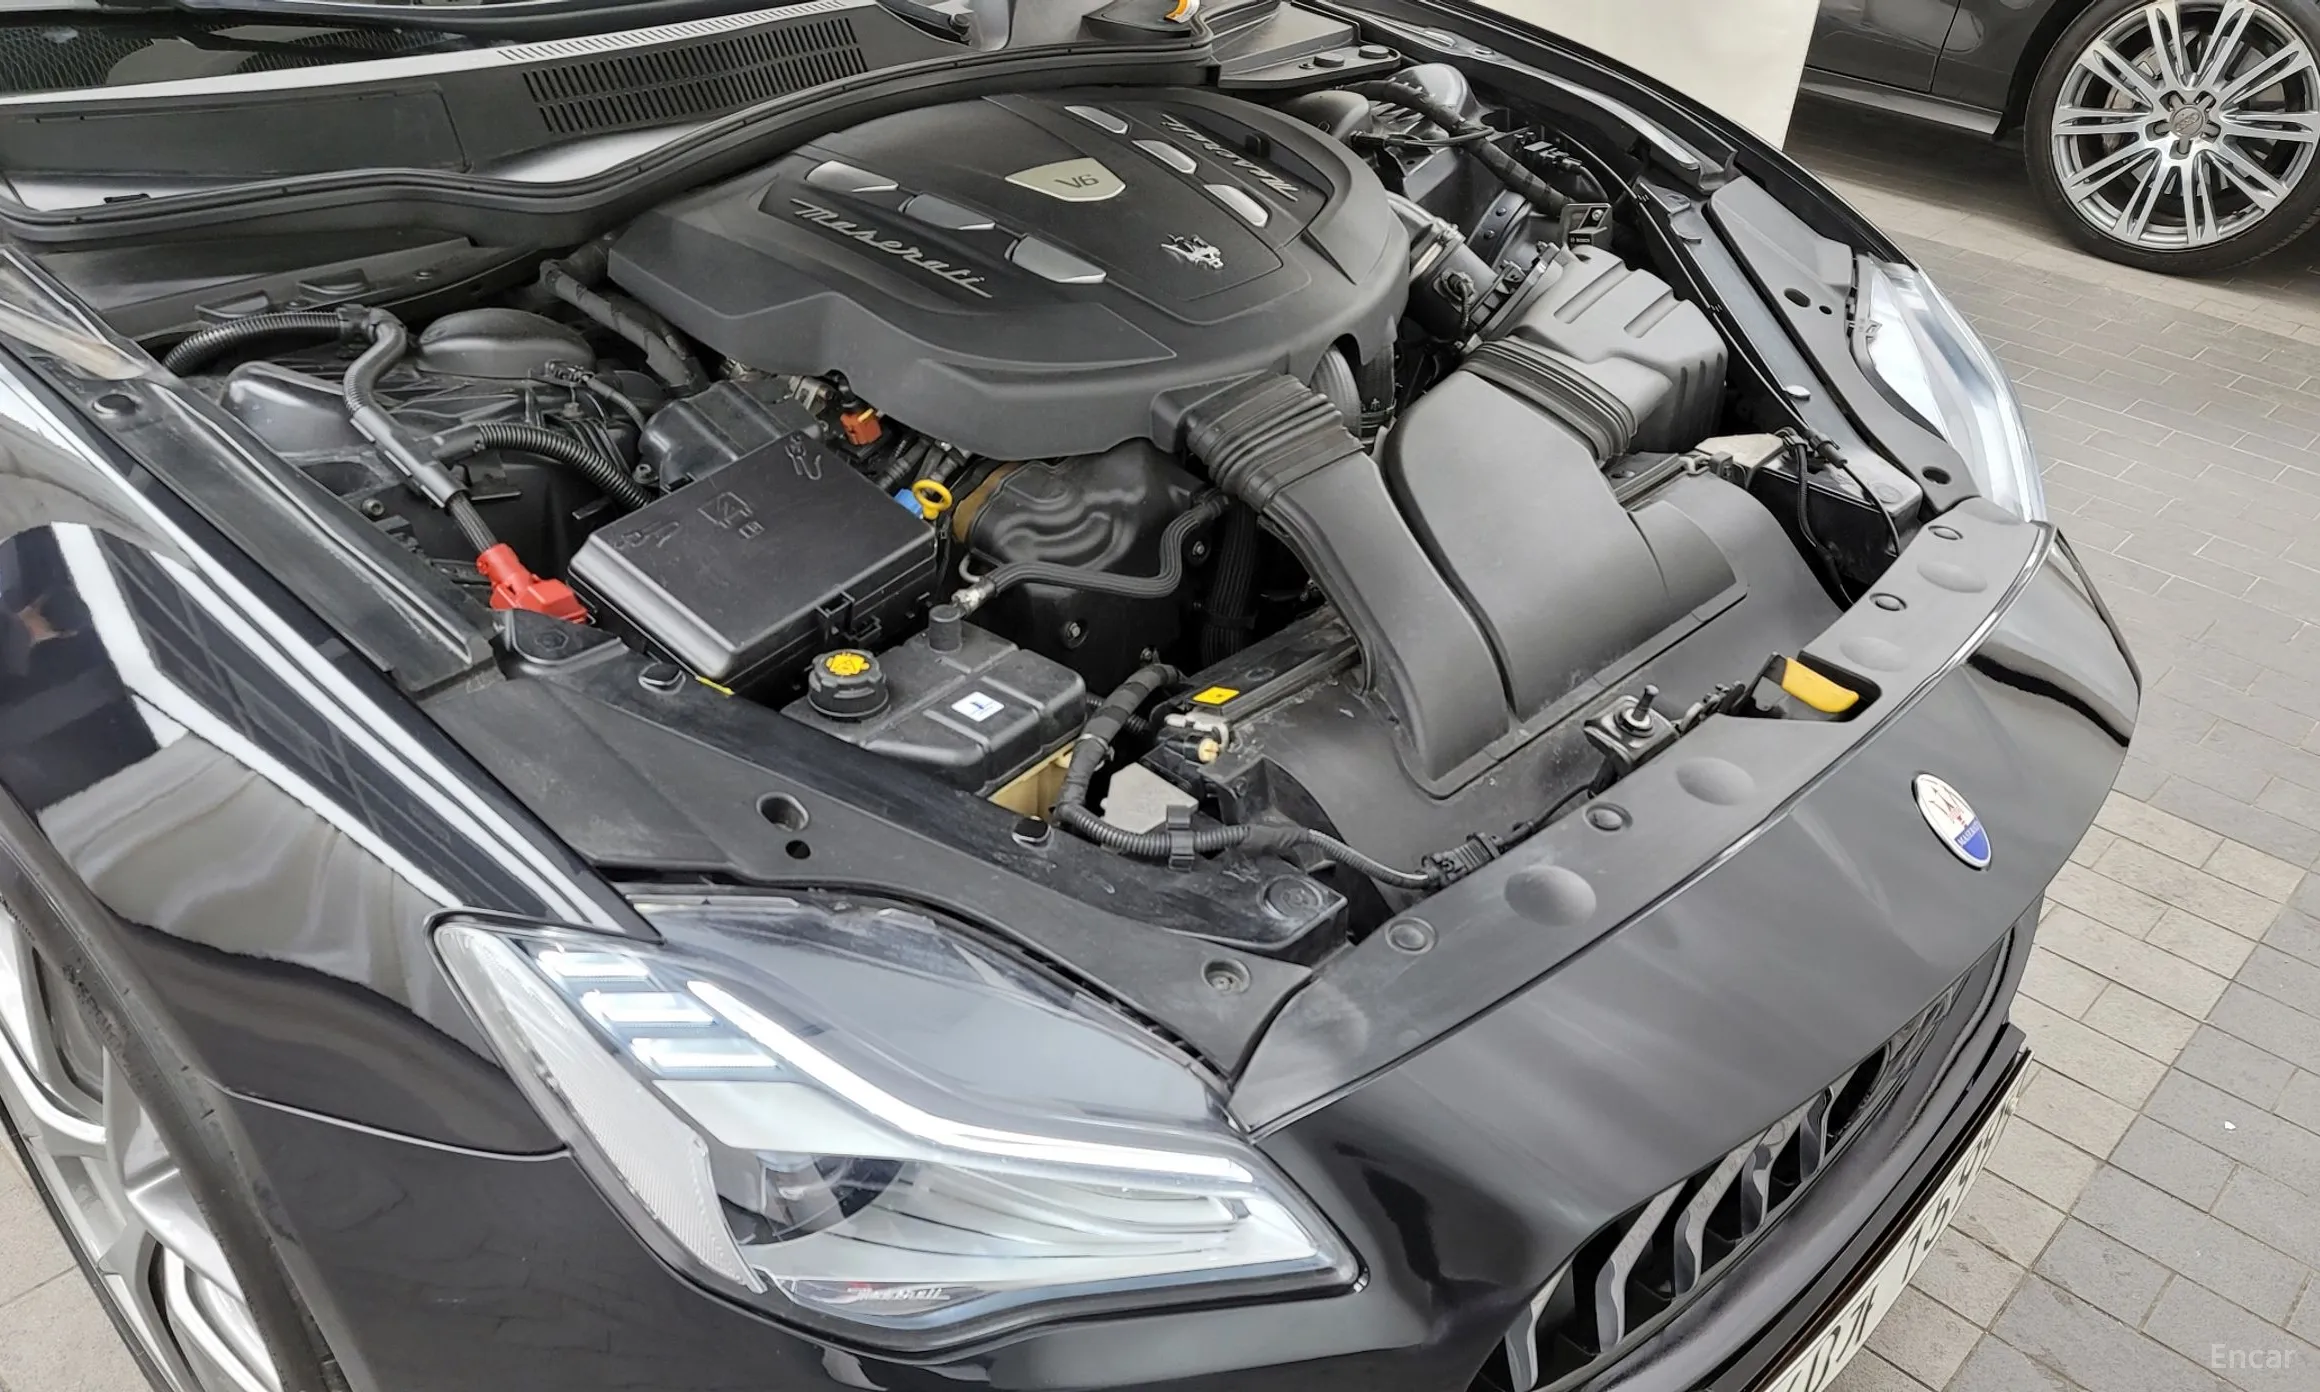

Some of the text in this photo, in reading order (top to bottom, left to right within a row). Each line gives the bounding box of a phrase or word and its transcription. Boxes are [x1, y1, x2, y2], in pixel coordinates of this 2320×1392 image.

[1053, 173, 1100, 189] V6
[1160, 113, 1299, 202] Maserati
[790, 197, 994, 299] Maserati
